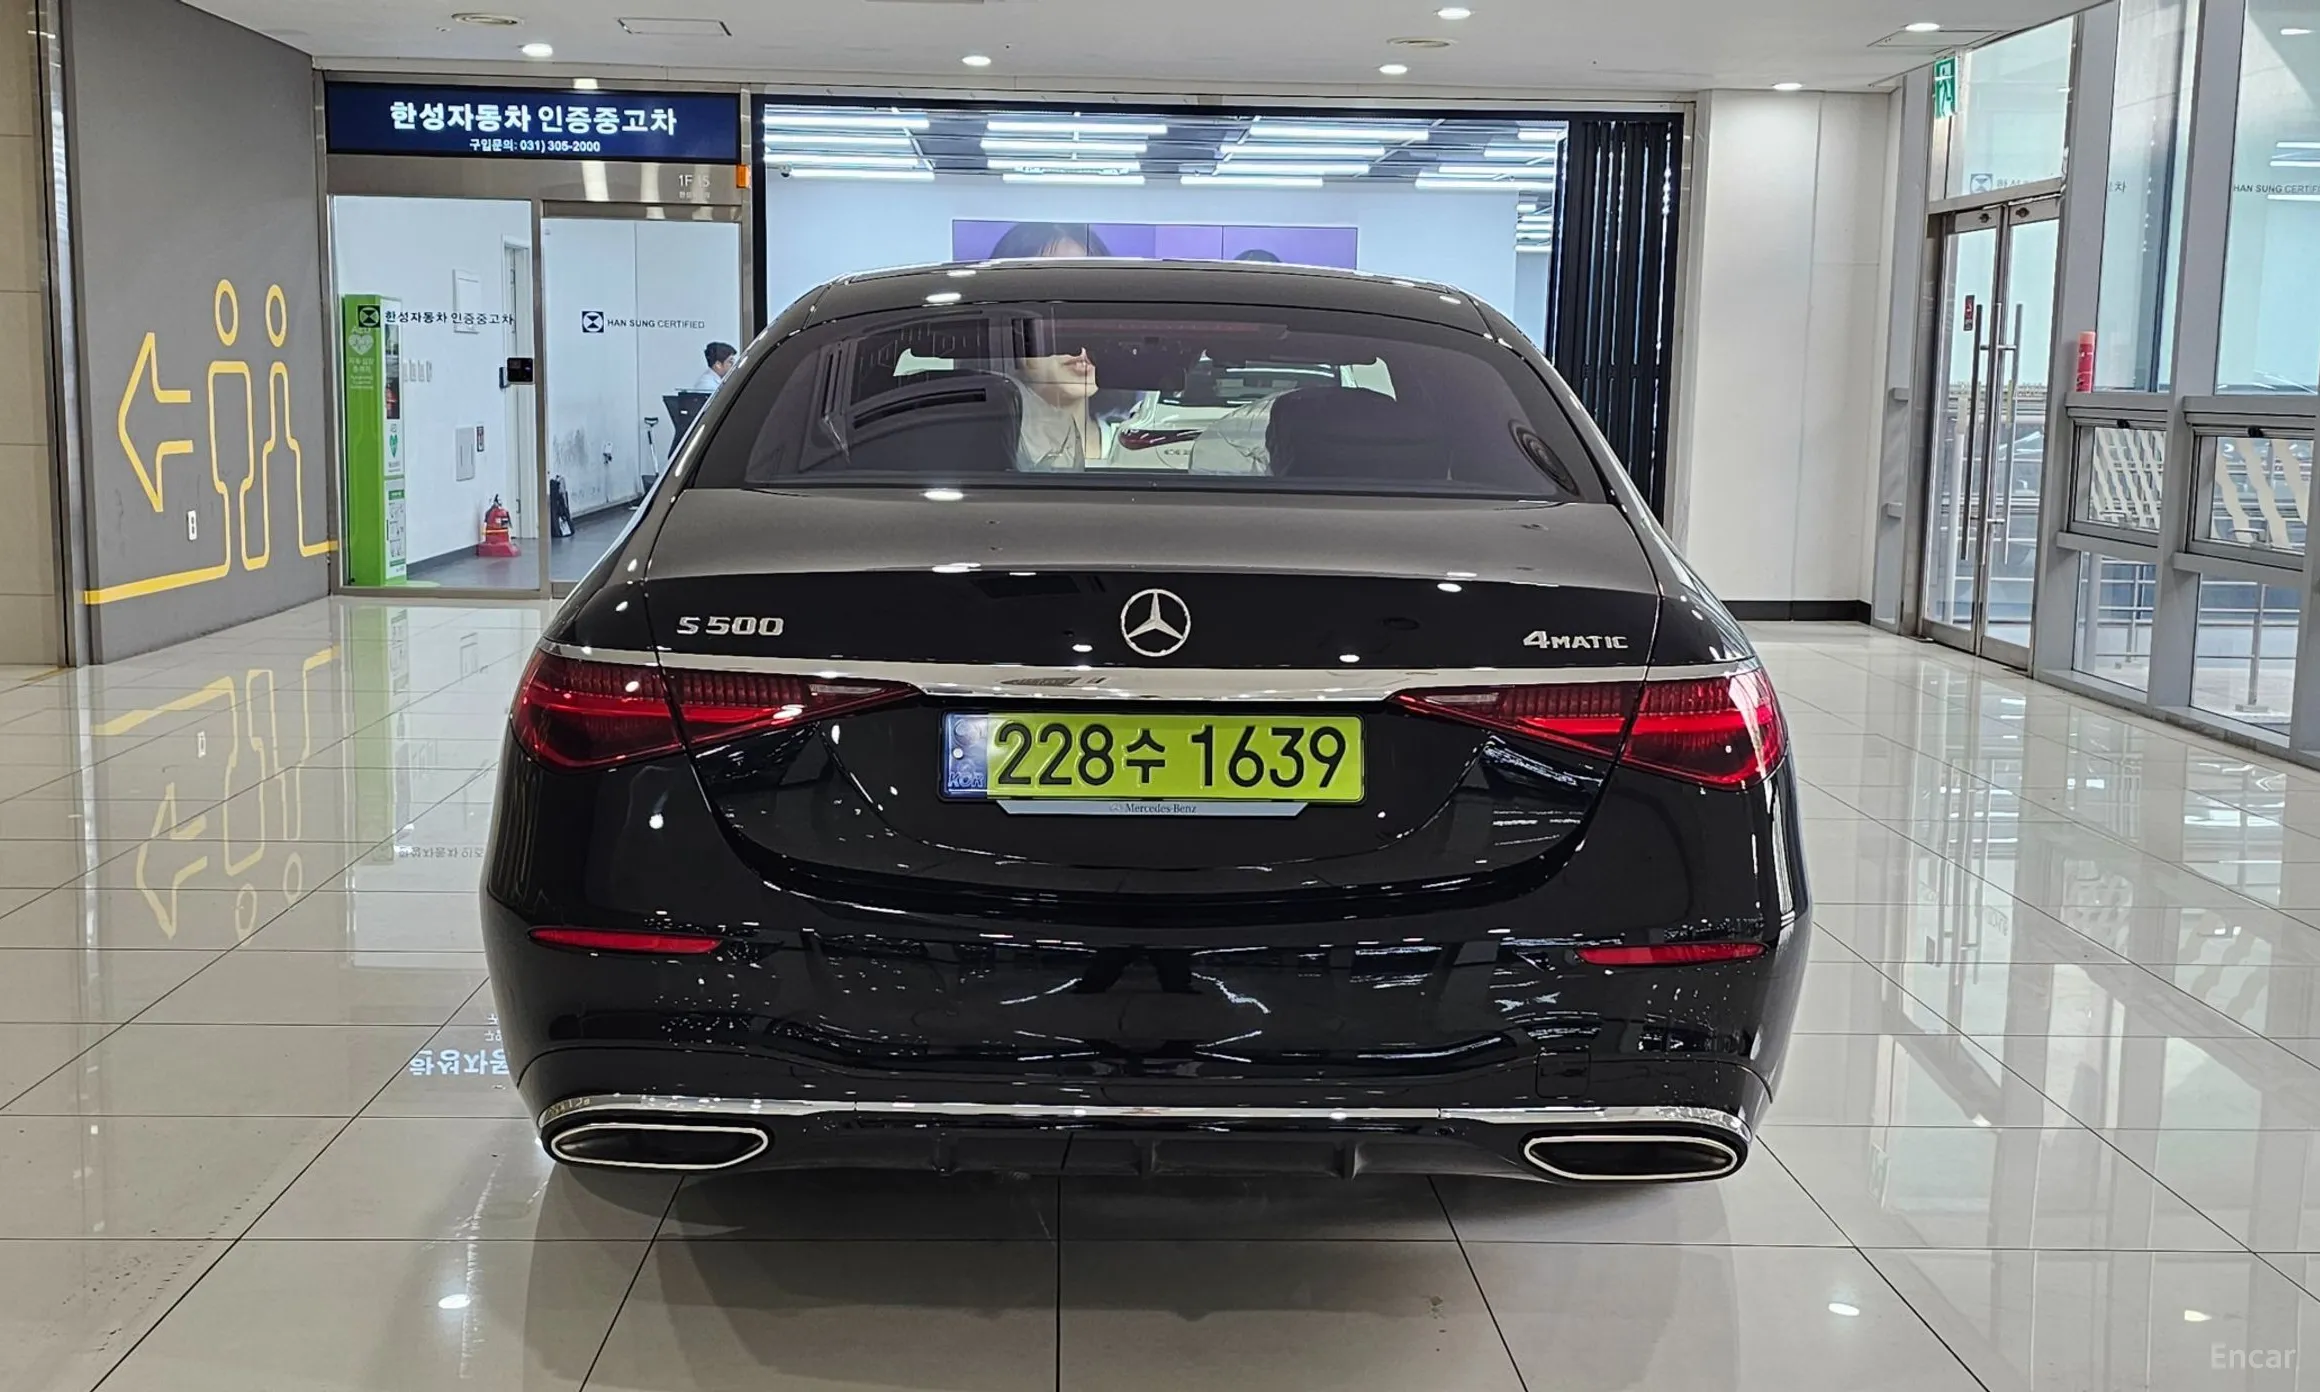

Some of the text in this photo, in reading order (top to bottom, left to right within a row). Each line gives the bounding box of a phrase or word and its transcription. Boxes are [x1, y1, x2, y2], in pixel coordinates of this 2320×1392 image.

[389, 101, 678, 136] 한성자동차 인증중고차
[469, 138, 601, 154] 구입문의: 031) 305-2000
[2233, 184, 2253, 193] HAN
[2255, 184, 2283, 194] SUNG
[384, 310, 516, 326] 한성자동차 인증중고차
[607, 319, 705, 329] HAN SUNG CERTIFIED
[676, 616, 785, 636] S 500
[1522, 630, 1629, 649] 4MATIC
[996, 722, 1347, 788] 228수 1639
[948, 771, 985, 788] KOR
